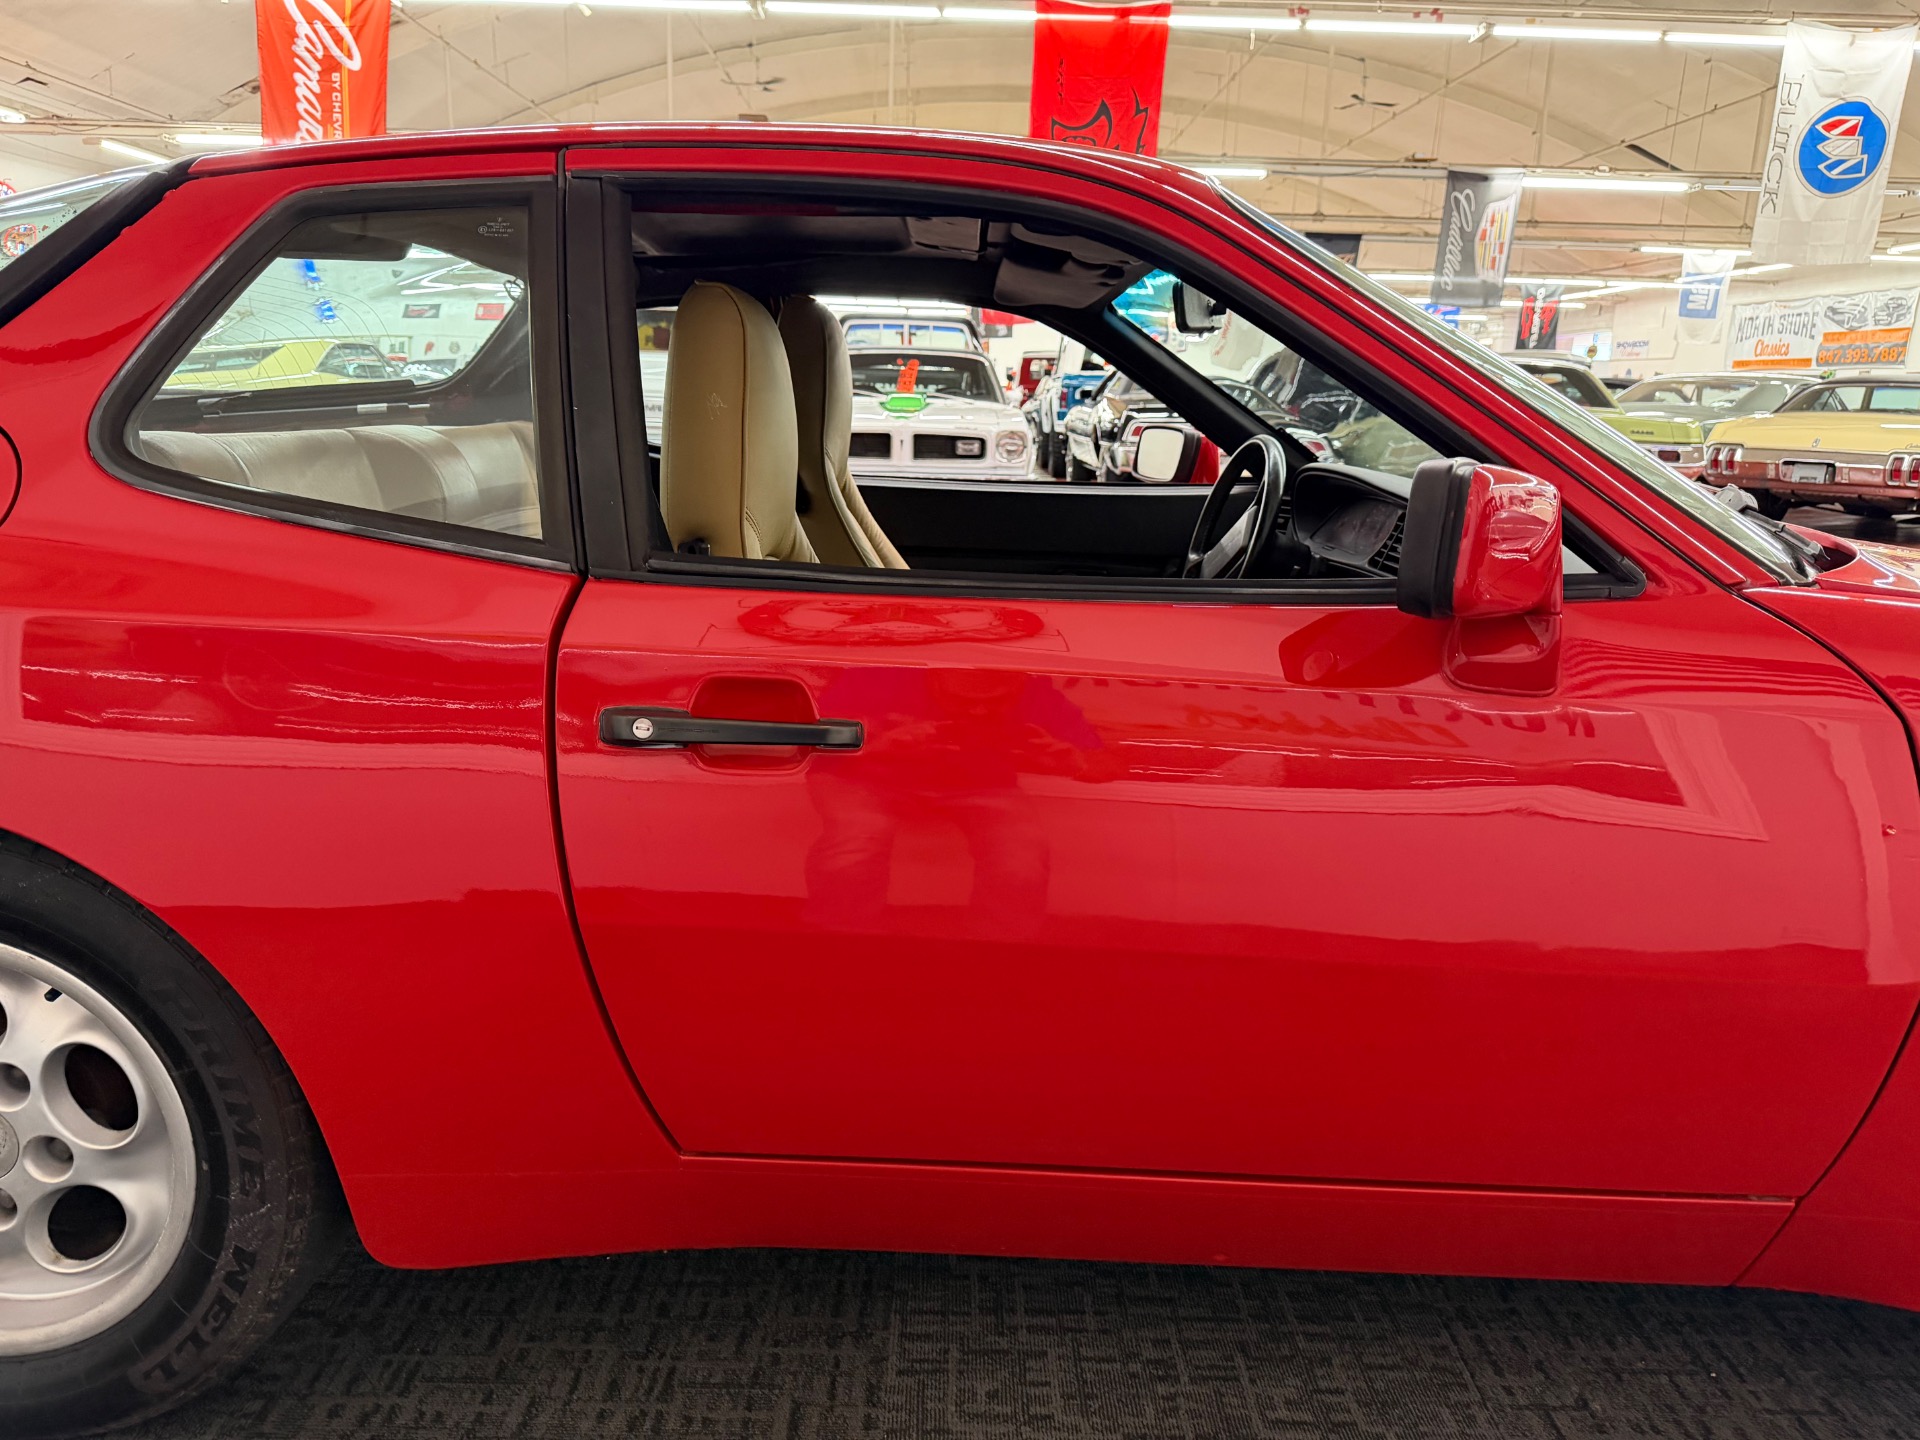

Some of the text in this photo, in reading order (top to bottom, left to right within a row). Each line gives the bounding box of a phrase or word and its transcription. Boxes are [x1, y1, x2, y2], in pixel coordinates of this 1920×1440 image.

[331, 72, 342, 90] BY
[1760, 73, 1805, 215] BUICK
[1441, 188, 1476, 291] Cadillac
[1735, 314, 1775, 344] NORTH
[1777, 311, 1820, 340] SHORE
[1754, 338, 1790, 358] Classics
